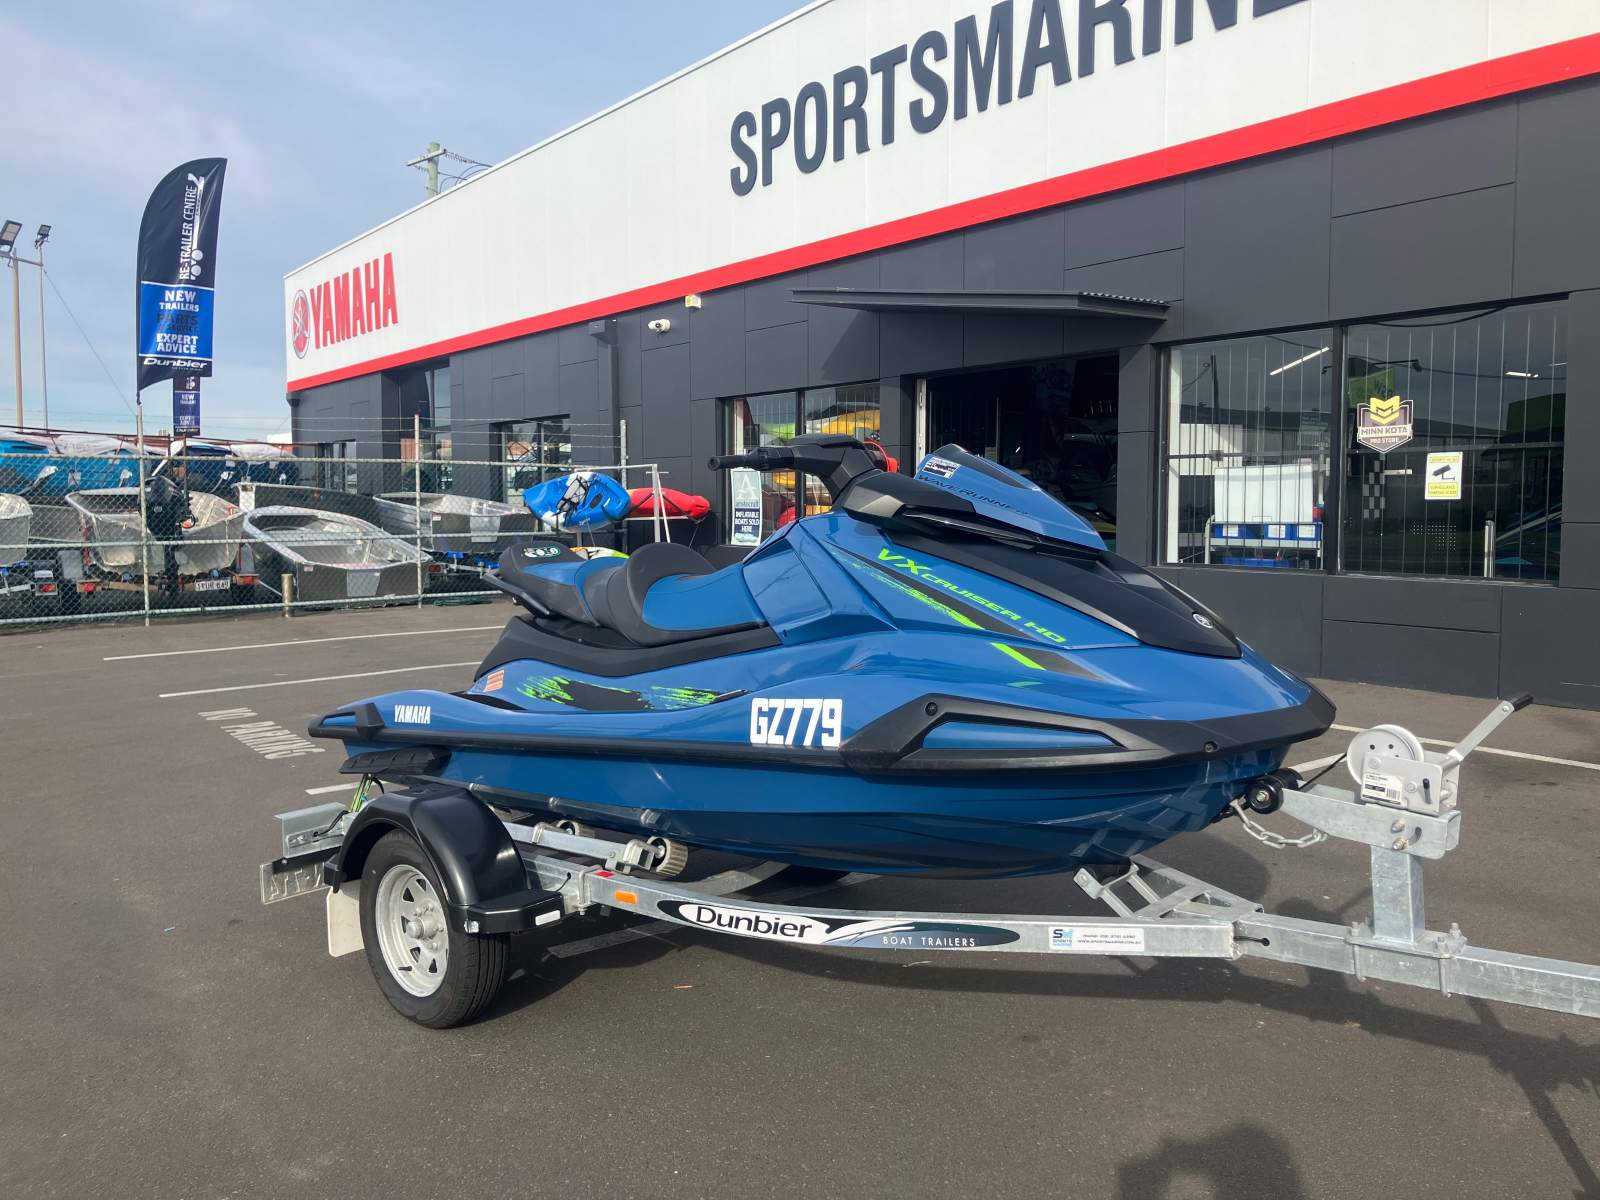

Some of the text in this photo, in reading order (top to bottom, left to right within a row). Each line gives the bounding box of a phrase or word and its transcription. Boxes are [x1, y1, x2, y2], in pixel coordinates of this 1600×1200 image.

[730, 0, 1308, 197] SPORTSMAR
[179, 185, 197, 280] RE-TRAILER CENTRE
[164, 289, 196, 302] NEW
[309, 252, 398, 349] YAMAHA
[159, 302, 199, 312] TRAILERS
[156, 333, 198, 344] EXPERT
[156, 342, 198, 354] ADVICE
[143, 357, 207, 368] Dunbier
[1361, 426, 1408, 436] MINN KOTA
[748, 518, 760, 526] SOLD
[878, 548, 932, 575] VX
[921, 573, 1022, 621] CRUISER
[394, 704, 431, 724] YAMAHA
[749, 697, 843, 747] GZ779
[198, 707, 326, 760] NO PARKING
[695, 905, 812, 938] Dunbier
[882, 936, 976, 948] BOAT TRAILERS
